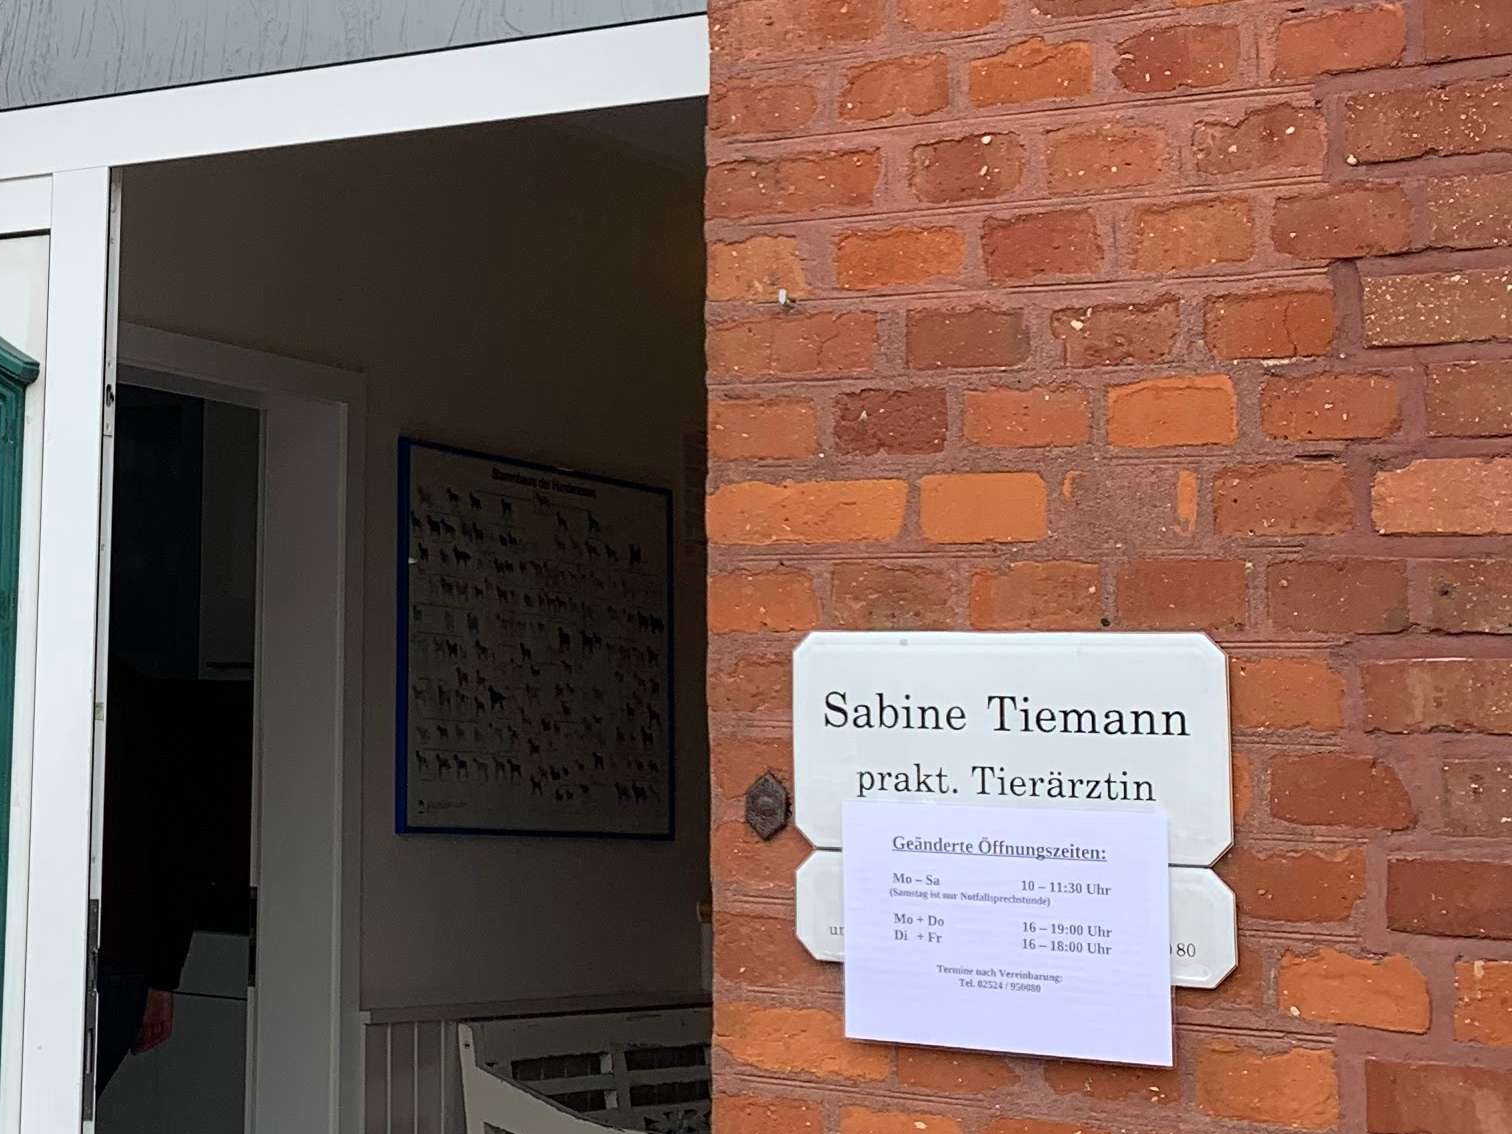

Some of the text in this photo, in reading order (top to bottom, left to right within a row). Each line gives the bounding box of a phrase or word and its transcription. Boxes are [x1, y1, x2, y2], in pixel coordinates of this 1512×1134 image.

[823, 690, 1191, 737] Sabine Tiemann
[856, 763, 1157, 802] prakt. Tierärztin
[892, 835, 1107, 861] Geänderte Öffnungszeiten:
[892, 872, 913, 885] Mo
[925, 874, 941, 886] Sa
[1021, 879, 1035, 891] 10
[1049, 881, 1083, 894] 11:30
[1086, 883, 1112, 896] Uhr
[889, 887, 1051, 907] (Samstag ist nur Notfallsprechstunde)
[893, 912, 914, 925] Mo
[927, 914, 945, 927] Do
[894, 929, 908, 941] Di
[927, 931, 943, 943] Fr
[1022, 921, 1037, 933] 16
[1050, 923, 1084, 936] 19:00
[1087, 924, 1113, 938] Uhr
[1022, 938, 1037, 950] 16
[1050, 939, 1083, 952] 18:00
[1087, 942, 1113, 955] Uhr
[936, 964, 1063, 985] Termine nach Vereinbarung:
[958, 978, 976, 988] Tel.
[977, 979, 1004, 990] 02524
